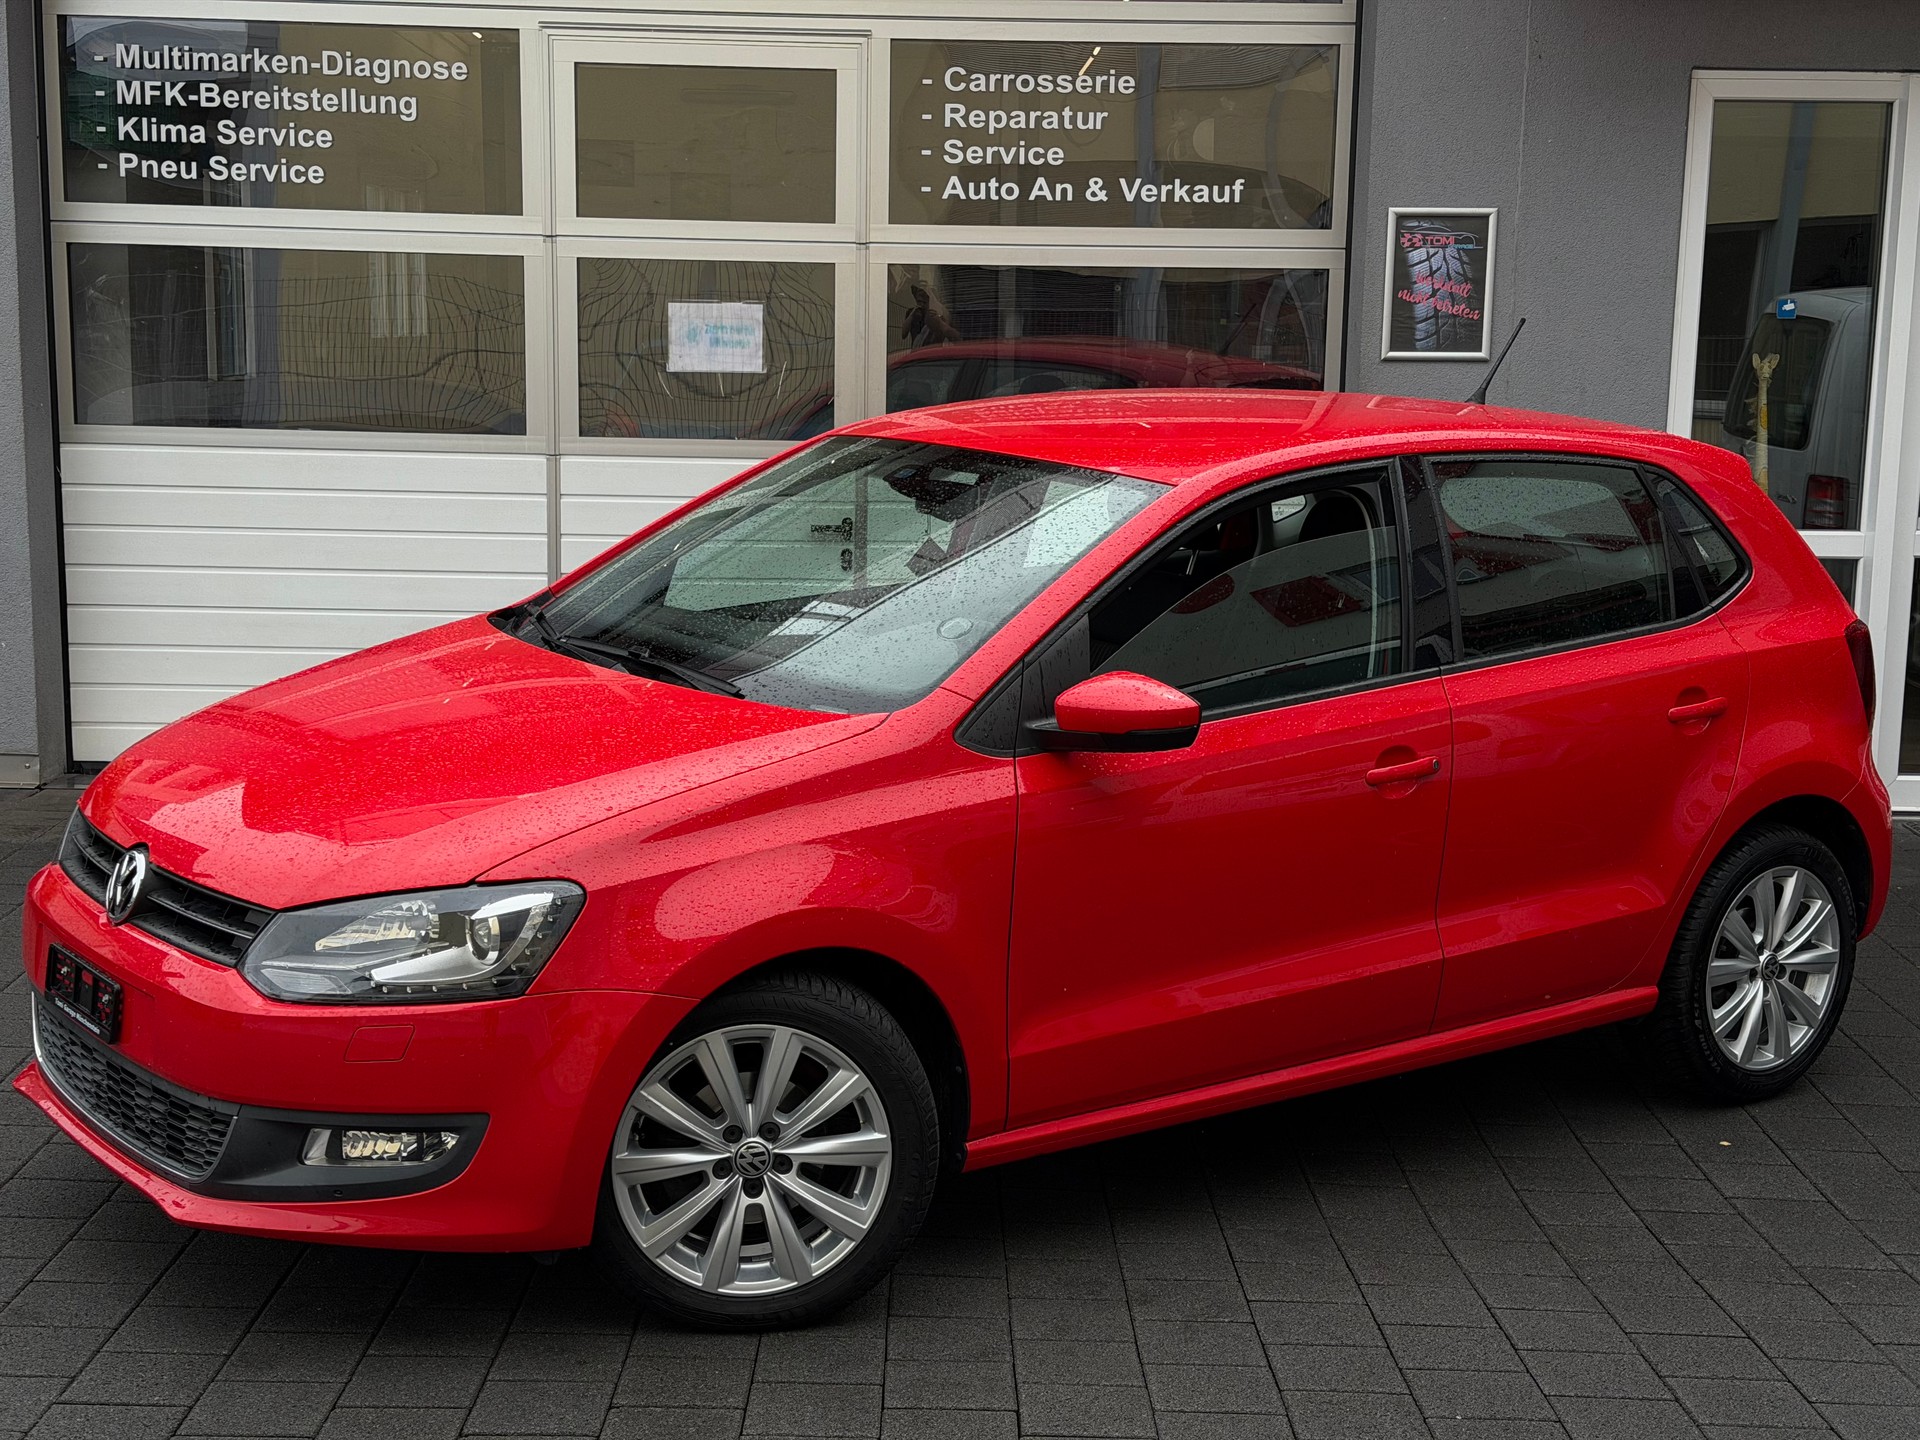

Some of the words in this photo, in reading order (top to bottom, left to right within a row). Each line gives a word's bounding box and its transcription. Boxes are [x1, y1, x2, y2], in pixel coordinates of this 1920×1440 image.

[115, 43, 468, 84] Multimarken-Diagnose
[944, 66, 1136, 94] Carrosserie
[116, 80, 417, 122] MFK-Bereitstellung
[118, 116, 206, 144] Klima
[217, 119, 333, 148] Service
[944, 103, 1109, 135] Reparatur
[119, 152, 197, 180] Pneu
[208, 155, 325, 184] Service
[943, 139, 1065, 166] Service
[941, 175, 1020, 201] Auto
[1028, 176, 1073, 201] An
[1085, 177, 1109, 202] &
[1118, 177, 1245, 203] Verkauf
[1425, 235, 1455, 246] TOMI
